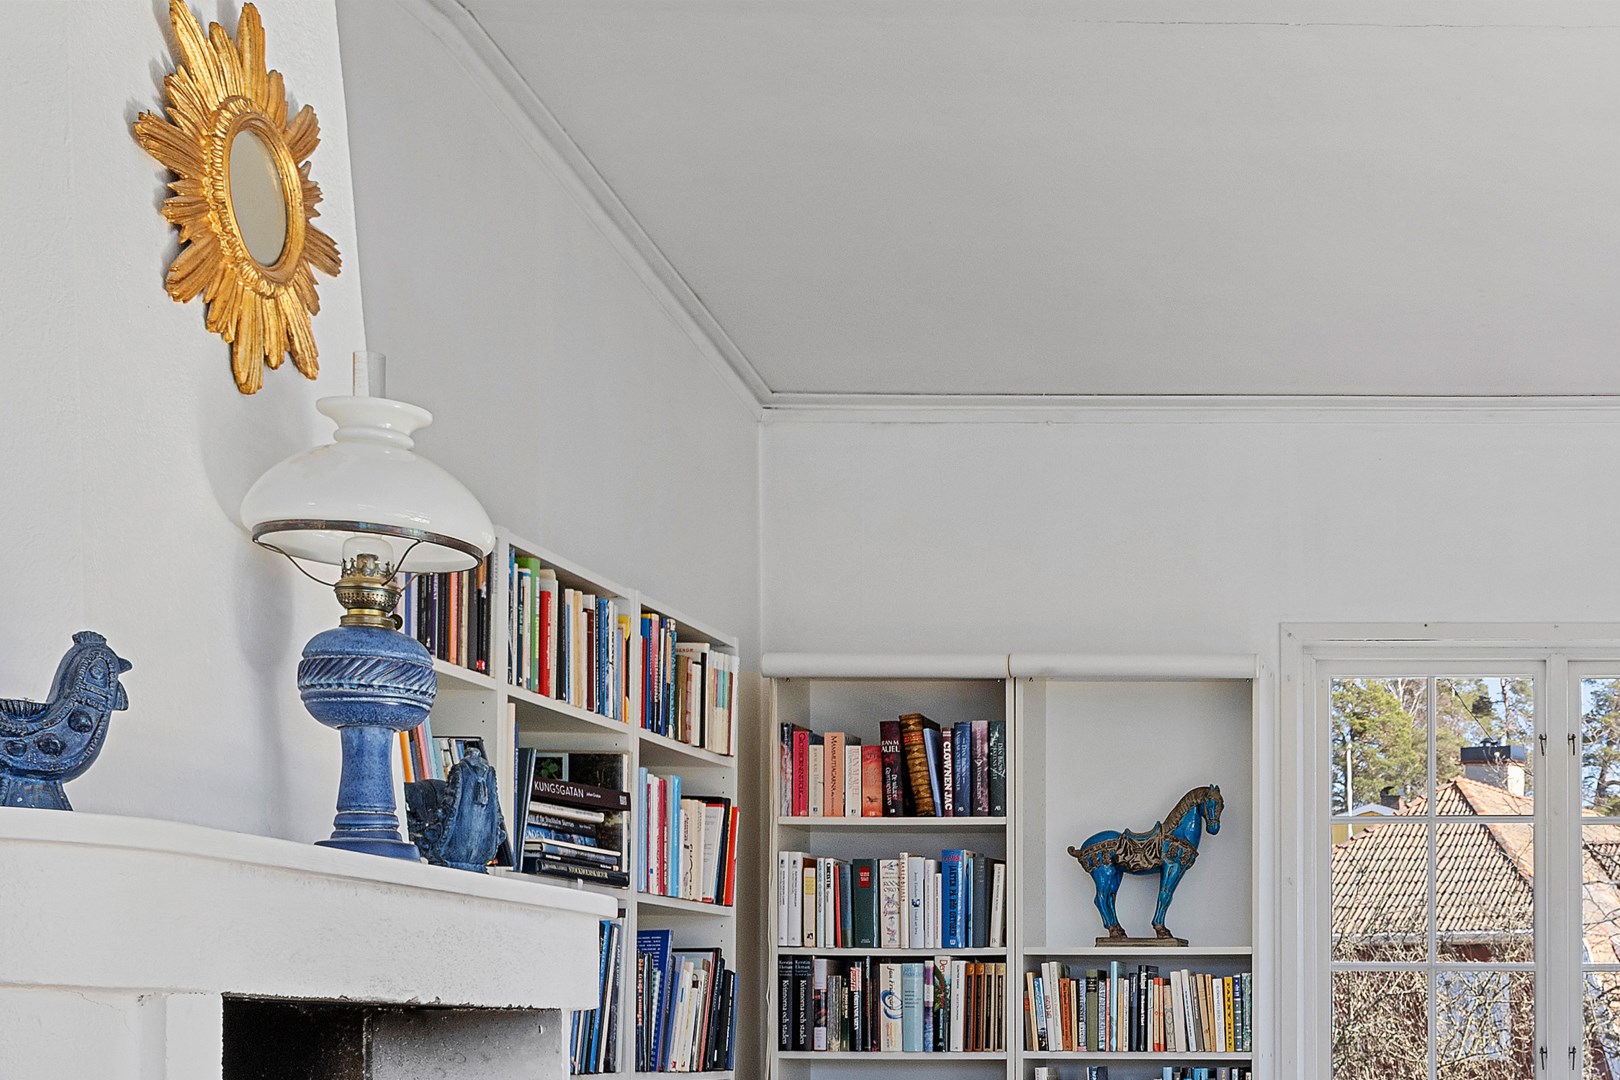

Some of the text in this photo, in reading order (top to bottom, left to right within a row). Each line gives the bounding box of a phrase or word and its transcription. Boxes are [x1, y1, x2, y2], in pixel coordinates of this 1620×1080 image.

[943, 742, 952, 810] CLOWNEN JAC
[534, 780, 584, 798] KUNGSGATAN
[948, 912, 957, 936] OKTOBER
[939, 960, 948, 972] Den
[799, 980, 807, 1044] Kvinnorna och staden
